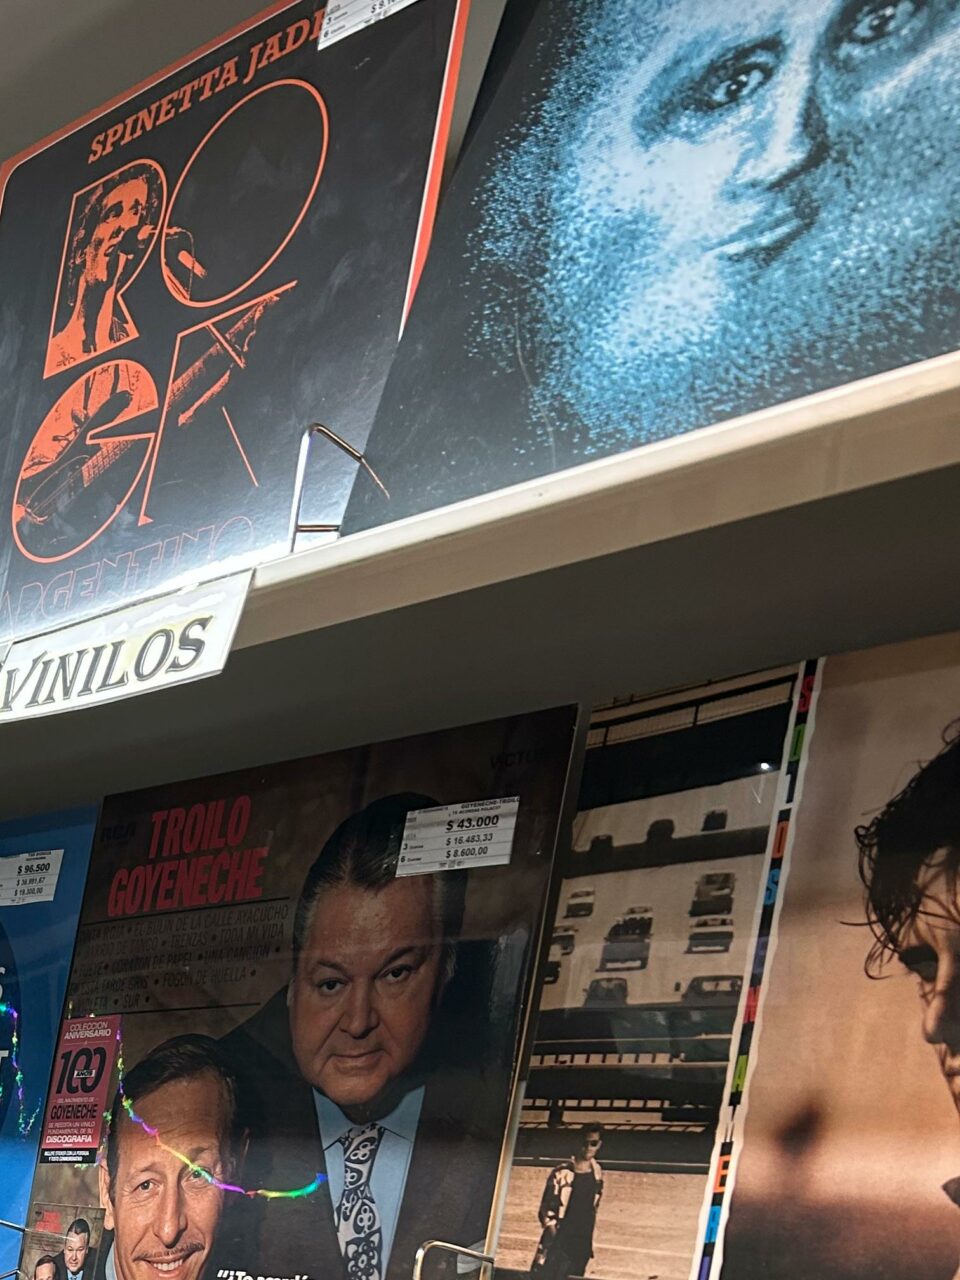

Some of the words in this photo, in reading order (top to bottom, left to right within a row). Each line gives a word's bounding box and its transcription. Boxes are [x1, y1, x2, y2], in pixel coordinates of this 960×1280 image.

[87, 65, 239, 165] SPINETTA
[148, 795, 251, 859] TROILO
[457, 815, 499, 829] 43.000
[454, 833, 493, 845] 16.483,33
[453, 847, 488, 858] 8.600,00
[24, 863, 50, 873] 96.500
[107, 846, 270, 917] GOYENECHE
[235, 904, 289, 923] AYACUCHO
[261, 922, 284, 938] VIDA
[123, 993, 141, 1009] SUR
[64, 1029, 112, 1040] ANIVERSARIO
[55, 1046, 107, 1094] 100
[50, 1104, 99, 1120] GOYENECHE
